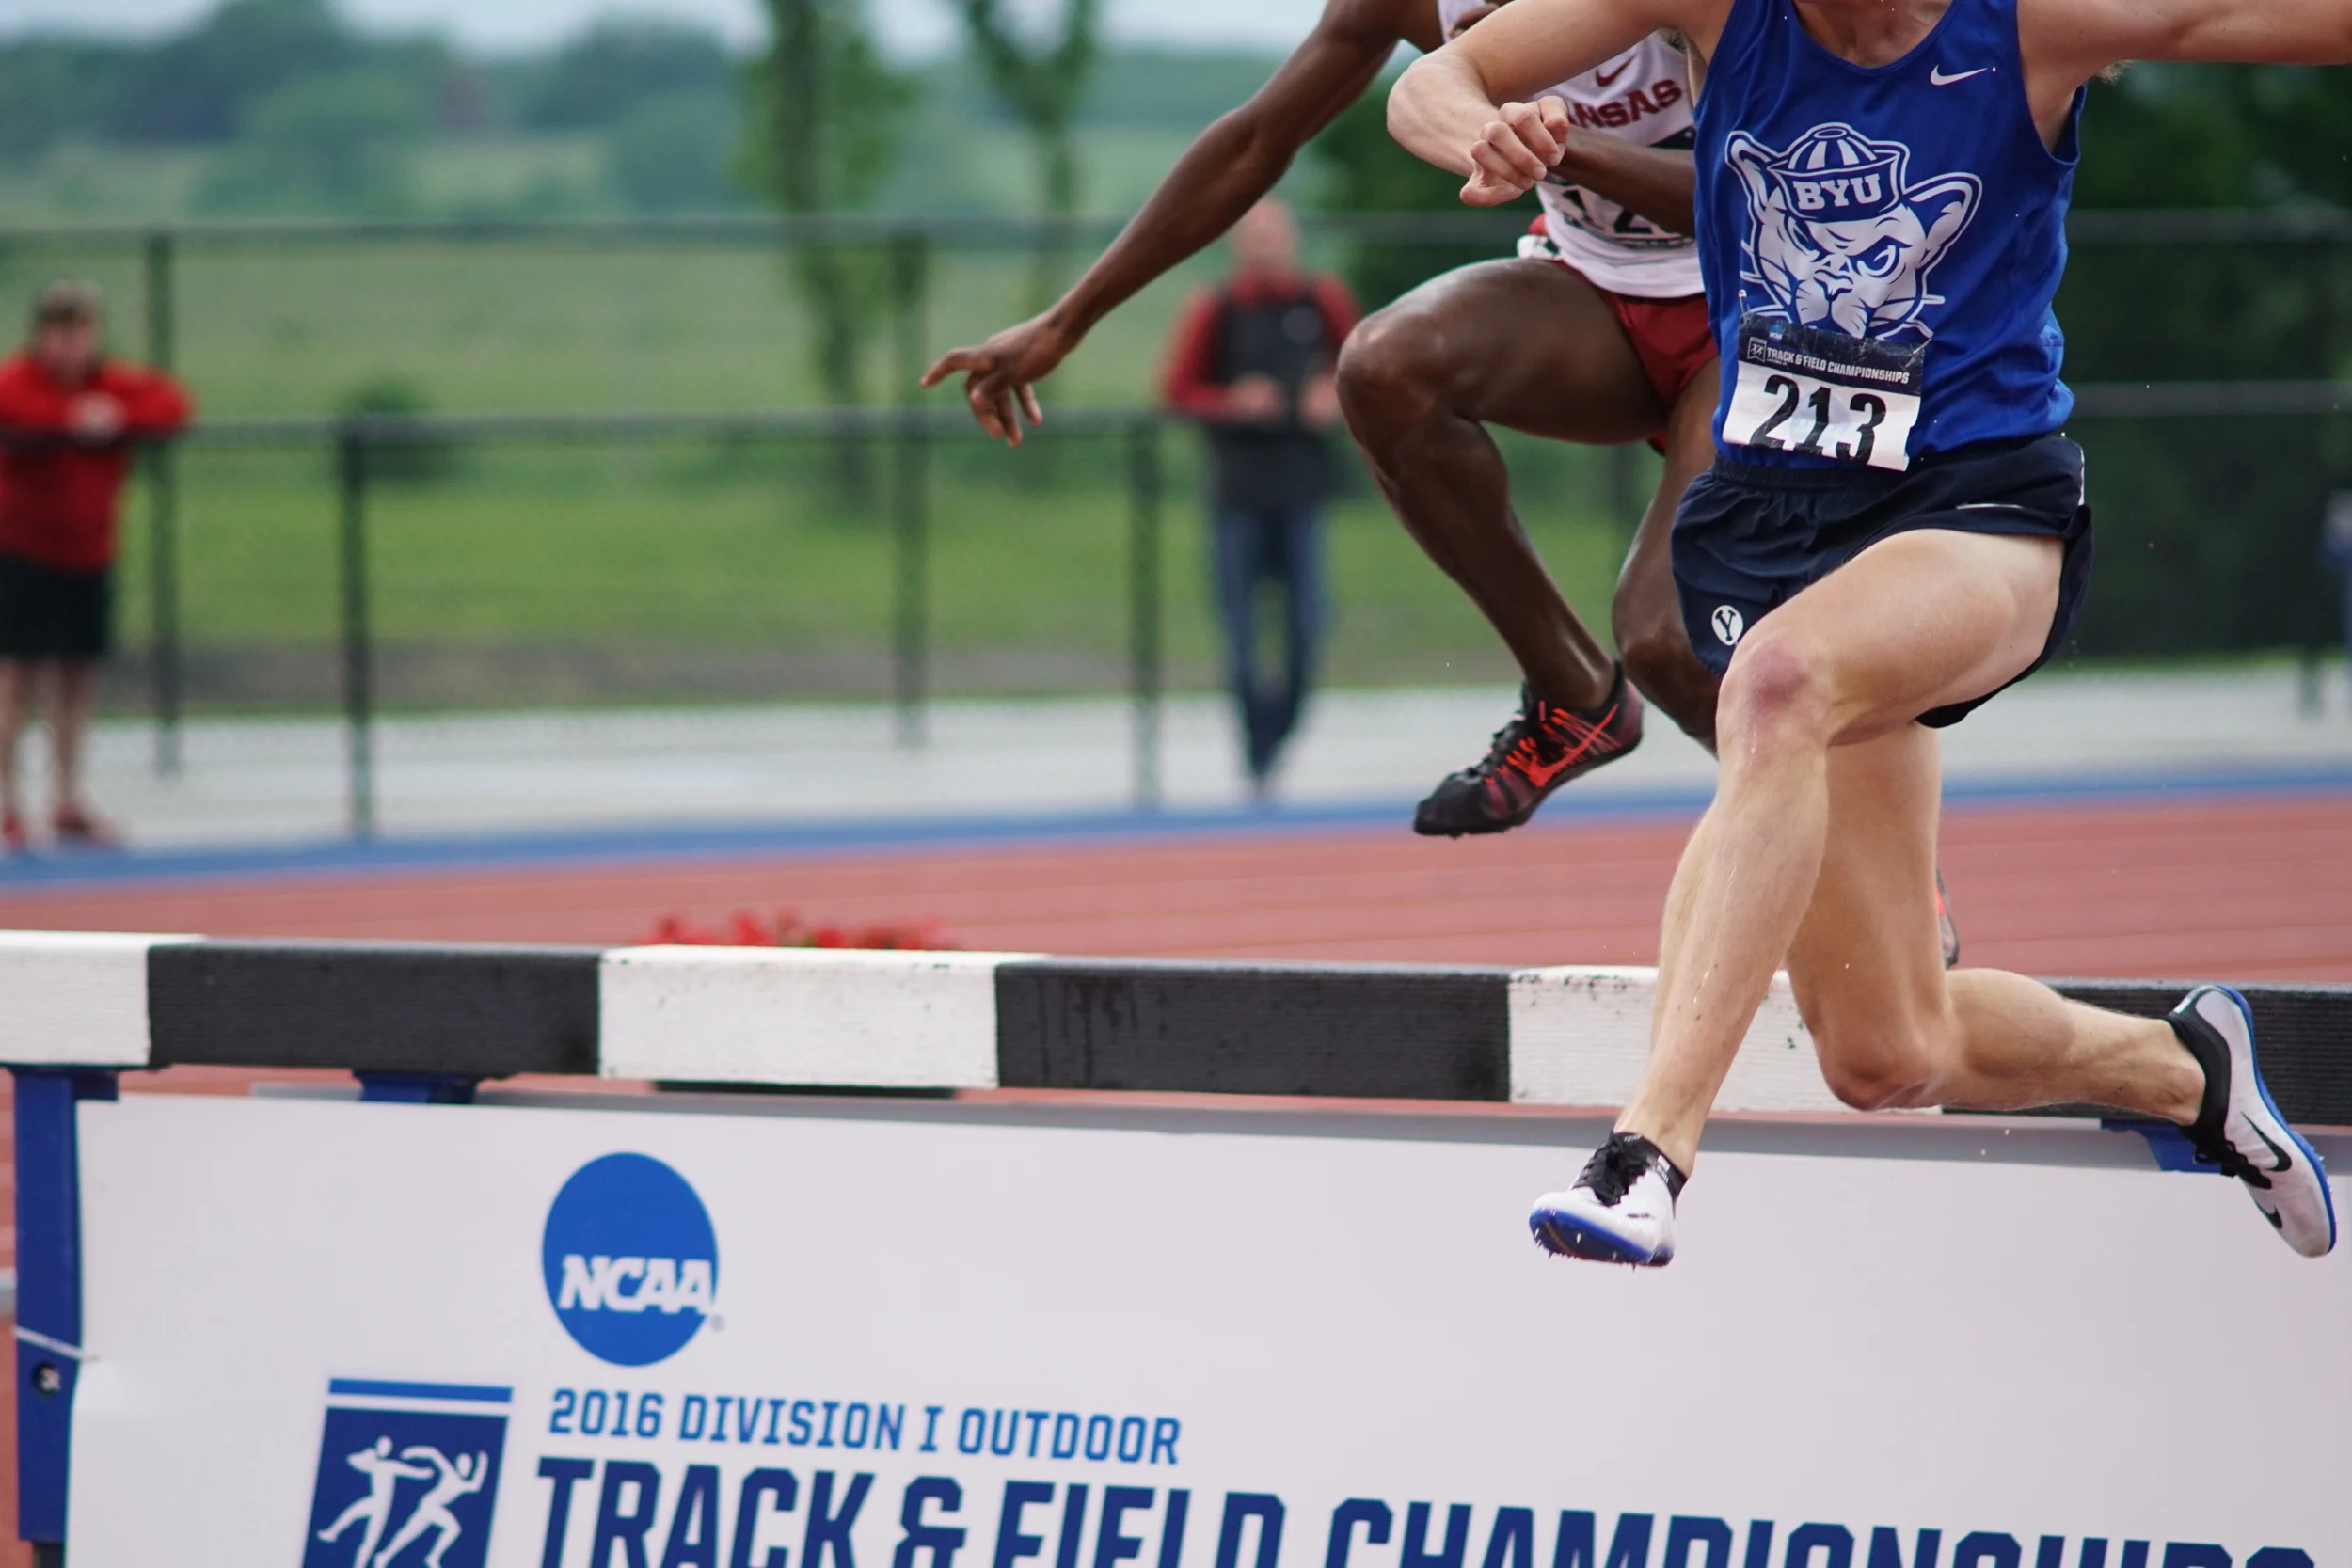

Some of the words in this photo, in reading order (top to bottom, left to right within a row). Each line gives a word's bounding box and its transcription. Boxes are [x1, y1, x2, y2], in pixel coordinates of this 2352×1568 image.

[1568, 79, 1682, 128] NSAS
[1792, 173, 1882, 210] BYU
[1767, 347, 1795, 364] TRACK
[1795, 355, 1803, 366] &
[1803, 355, 1827, 372] FIELD
[1827, 362, 1910, 384] CHAMPIONSHIPS
[1748, 374, 1887, 465] 213
[1715, 610, 1737, 641] Y
[558, 1254, 714, 1316] NCAA
[548, 1387, 664, 1439] 2016
[678, 1394, 906, 1452] DIVISION
[918, 1405, 944, 1453] I
[957, 1408, 1182, 1465] OUTDOOR
[537, 1456, 876, 1568] TRACK
[892, 1475, 967, 1568] &
